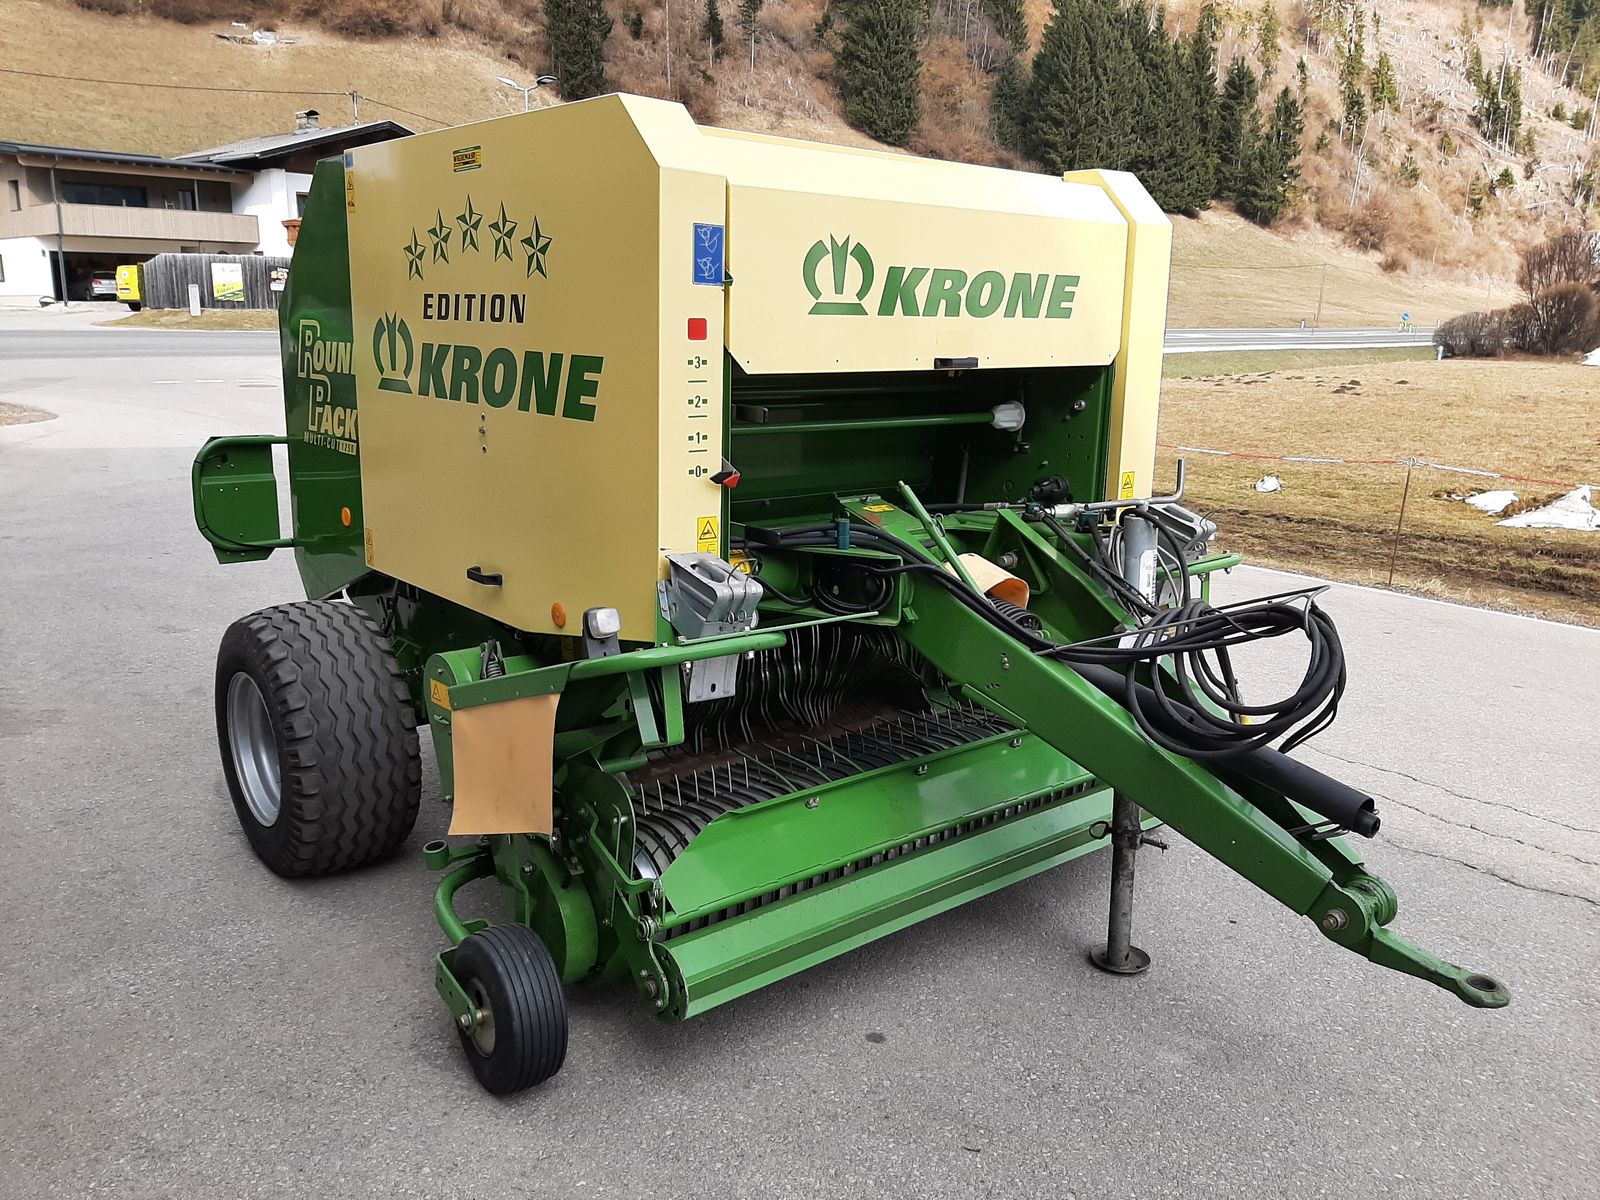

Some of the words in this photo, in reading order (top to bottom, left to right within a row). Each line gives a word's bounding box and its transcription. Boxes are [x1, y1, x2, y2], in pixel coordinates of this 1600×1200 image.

[876, 266, 1080, 319] KRONE
[422, 293, 526, 324] EDITION
[298, 319, 356, 377] ROUN
[694, 356, 701, 369] 3
[418, 342, 604, 422] KRONE
[308, 373, 358, 441] PACK
[694, 395, 701, 408] 2
[303, 431, 340, 451] MULTI-CUT
[695, 431, 701, 444] 1
[695, 465, 701, 478] 0
